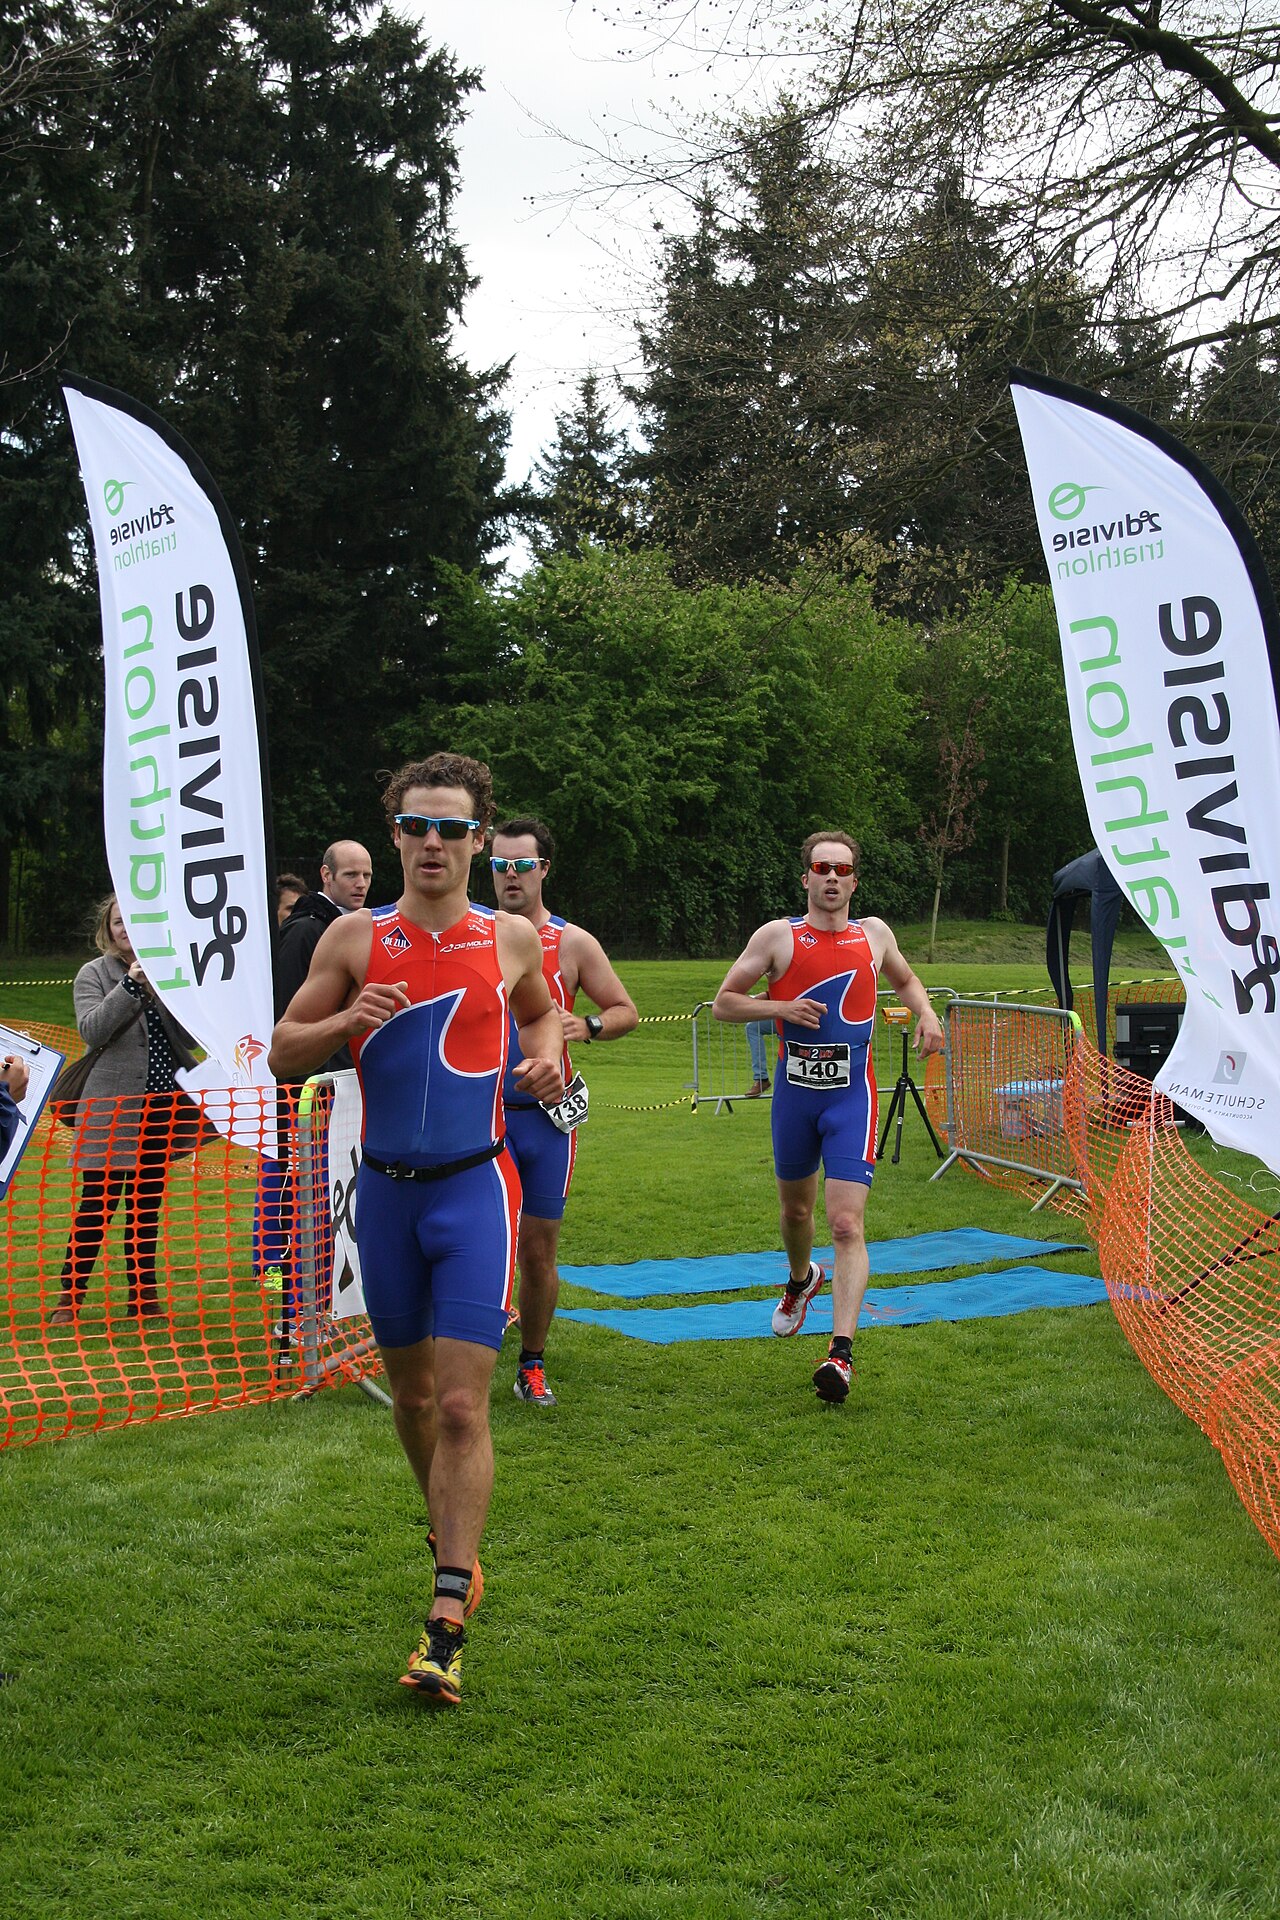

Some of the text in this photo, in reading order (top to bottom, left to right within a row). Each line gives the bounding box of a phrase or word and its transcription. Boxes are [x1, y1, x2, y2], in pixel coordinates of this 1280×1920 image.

[466, 939, 494, 948] MOLEN
[798, 1060, 839, 1079] 140
[553, 1093, 588, 1121] 138
